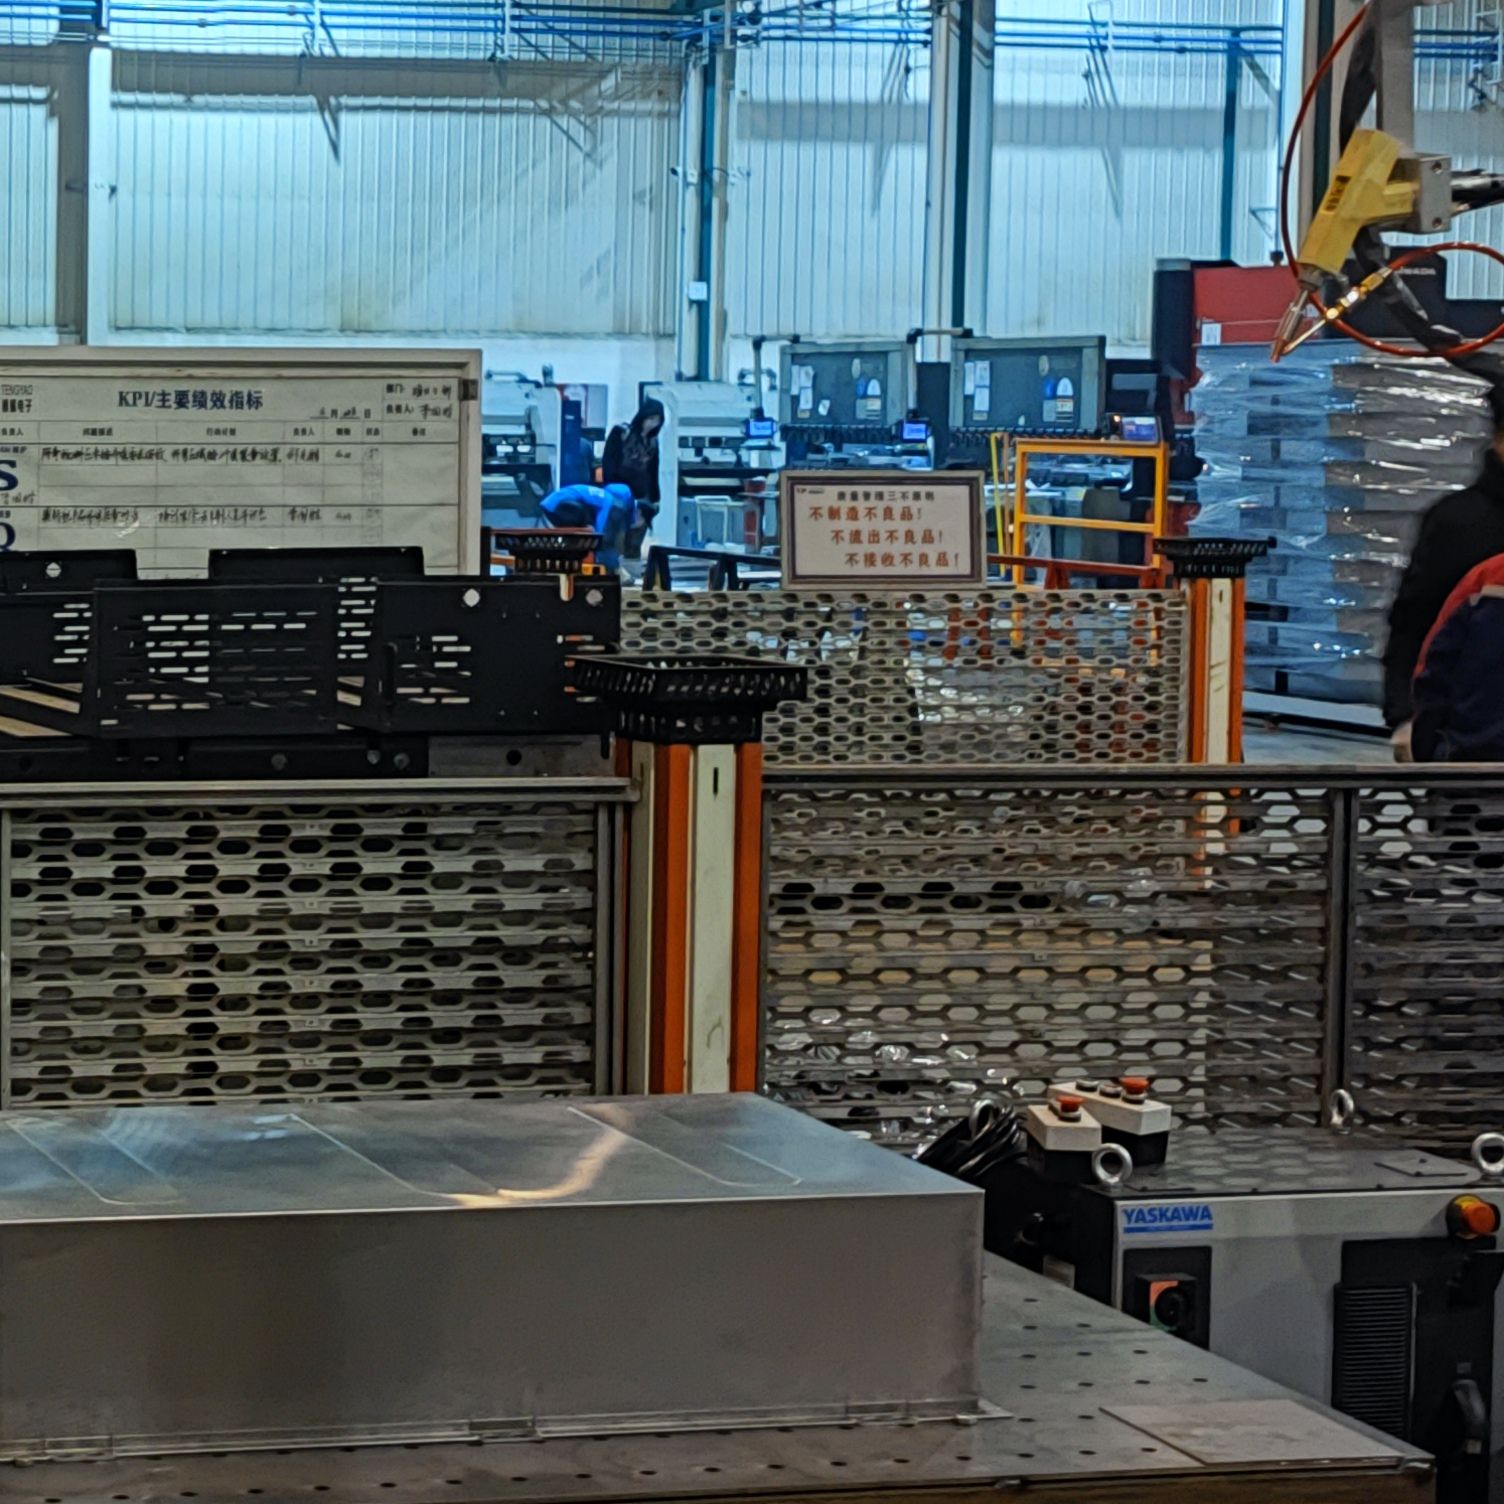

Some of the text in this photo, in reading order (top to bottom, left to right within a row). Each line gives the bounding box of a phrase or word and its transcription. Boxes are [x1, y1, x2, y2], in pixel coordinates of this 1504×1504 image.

[117, 389, 264, 410] KPI/主要绩效指标
[1123, 1205, 1214, 1224] YASKAWA
